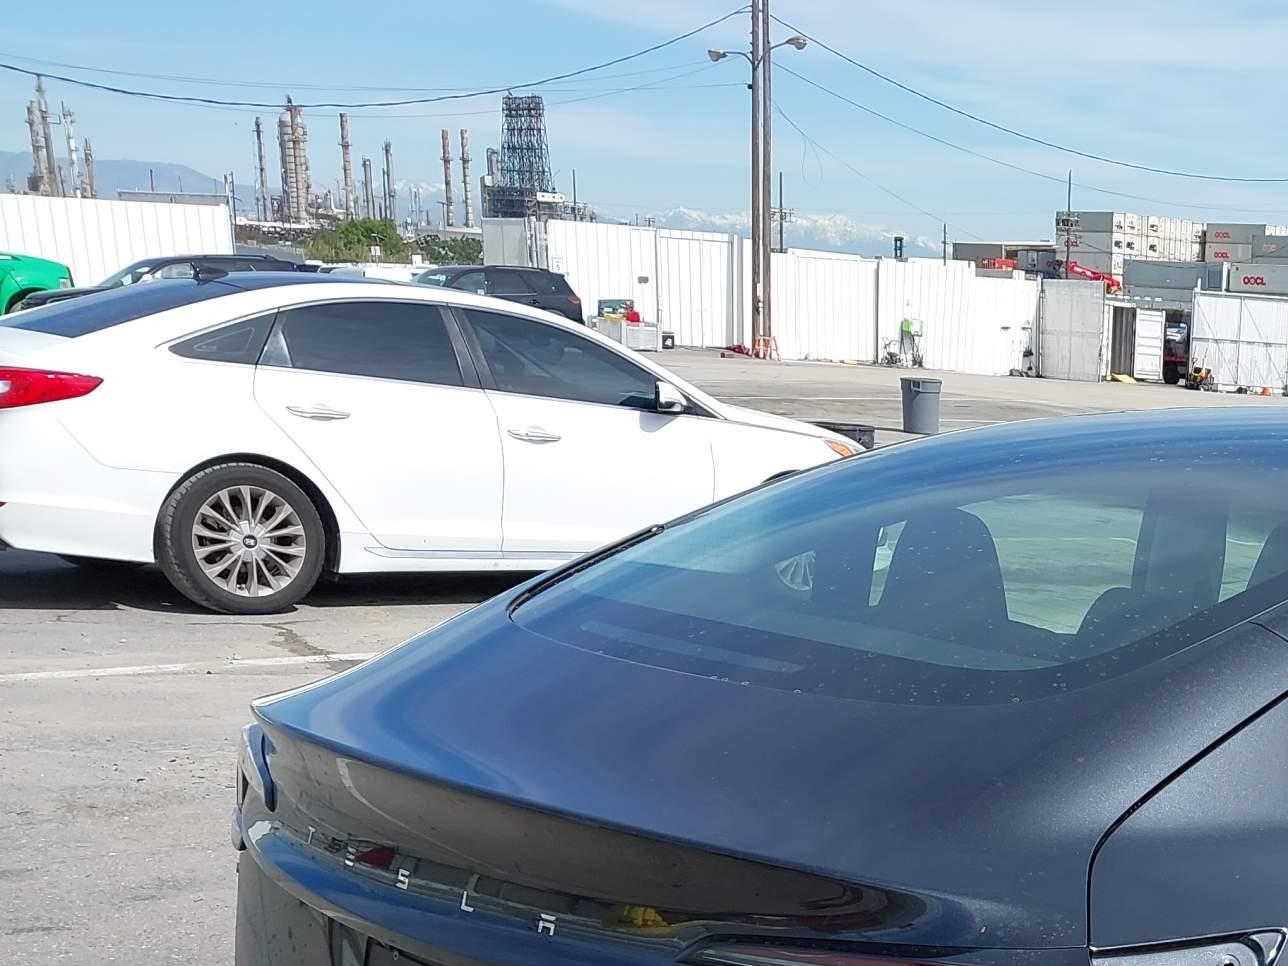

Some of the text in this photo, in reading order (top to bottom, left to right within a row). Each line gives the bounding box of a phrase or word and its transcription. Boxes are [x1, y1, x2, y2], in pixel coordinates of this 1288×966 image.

[1215, 231, 1231, 239] OOCL
[1214, 251, 1230, 259] OOCL
[1243, 276, 1266, 286] OOCL
[307, 826, 557, 936] TESLA
